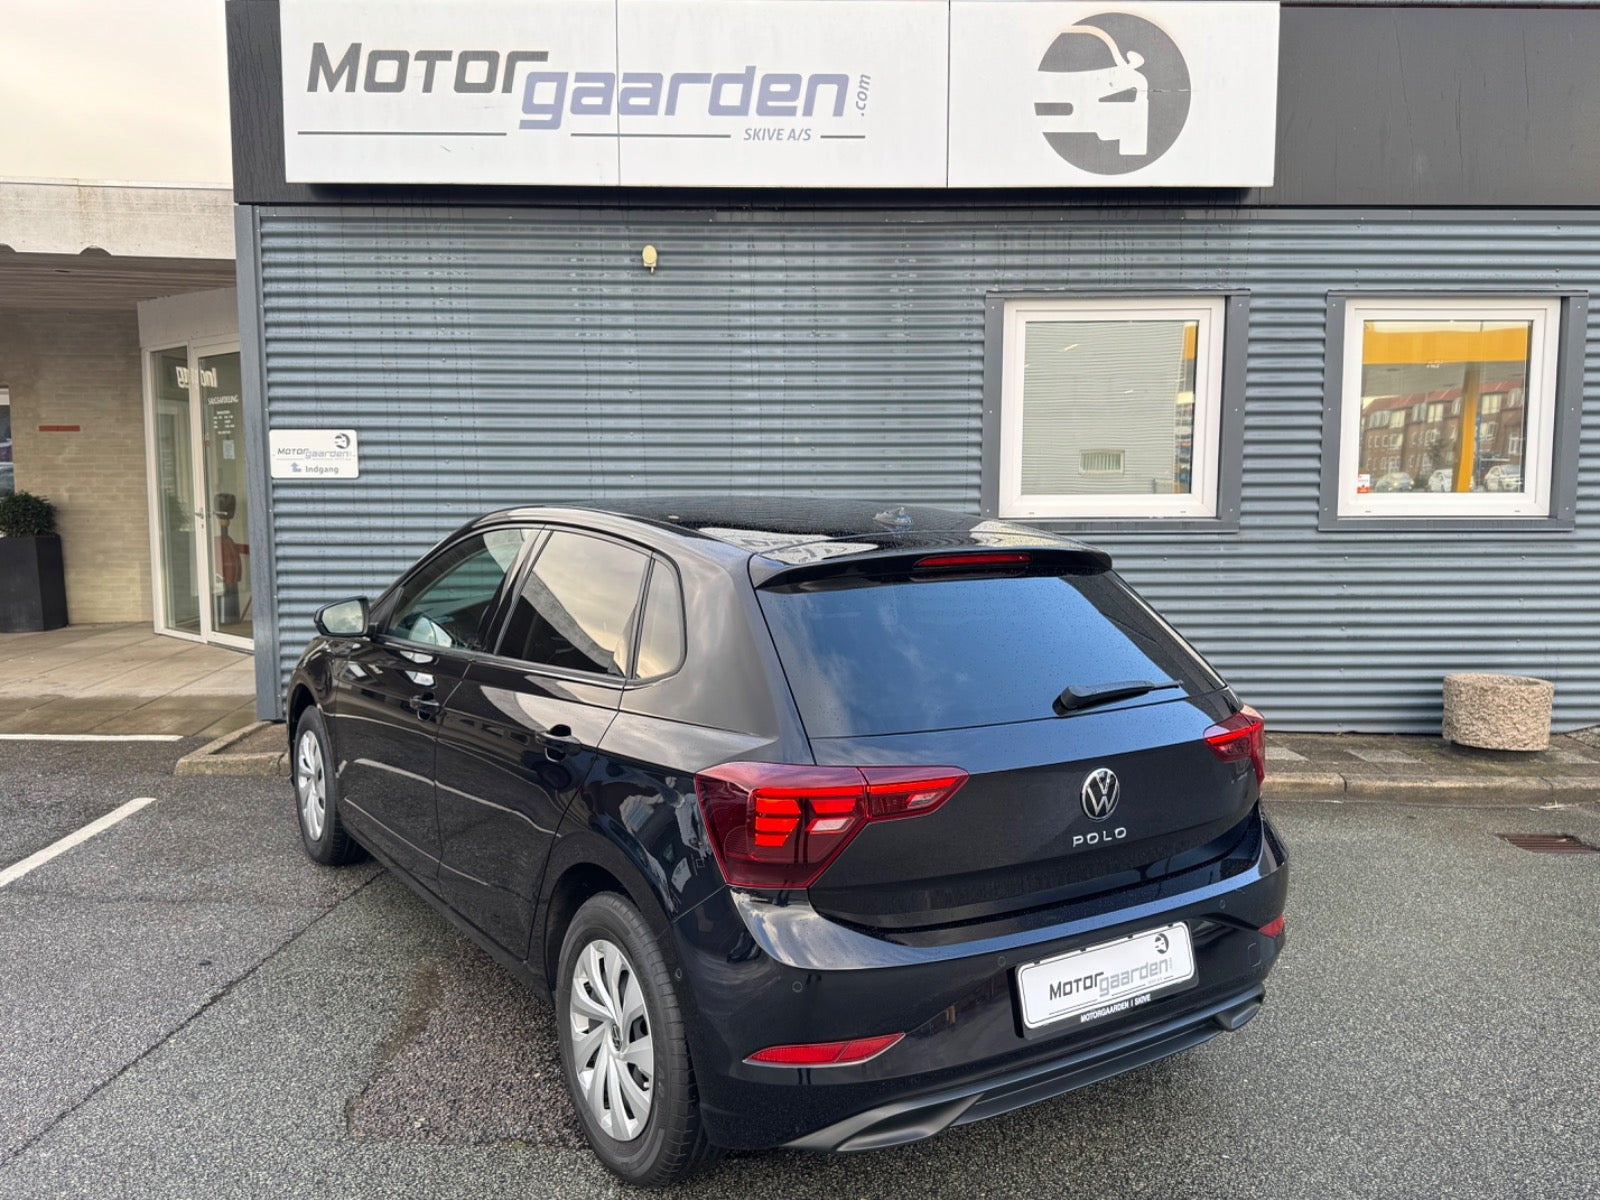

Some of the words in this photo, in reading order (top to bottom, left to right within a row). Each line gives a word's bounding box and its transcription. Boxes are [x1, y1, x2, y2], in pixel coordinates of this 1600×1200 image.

[856, 73, 872, 117] .com
[743, 128, 784, 141] SKIVE
[787, 128, 812, 141] A/S
[305, 465, 339, 475] Indgang
[1072, 827, 1127, 847] POLO
[1080, 1000, 1129, 1022] MOTORGAARDEN
